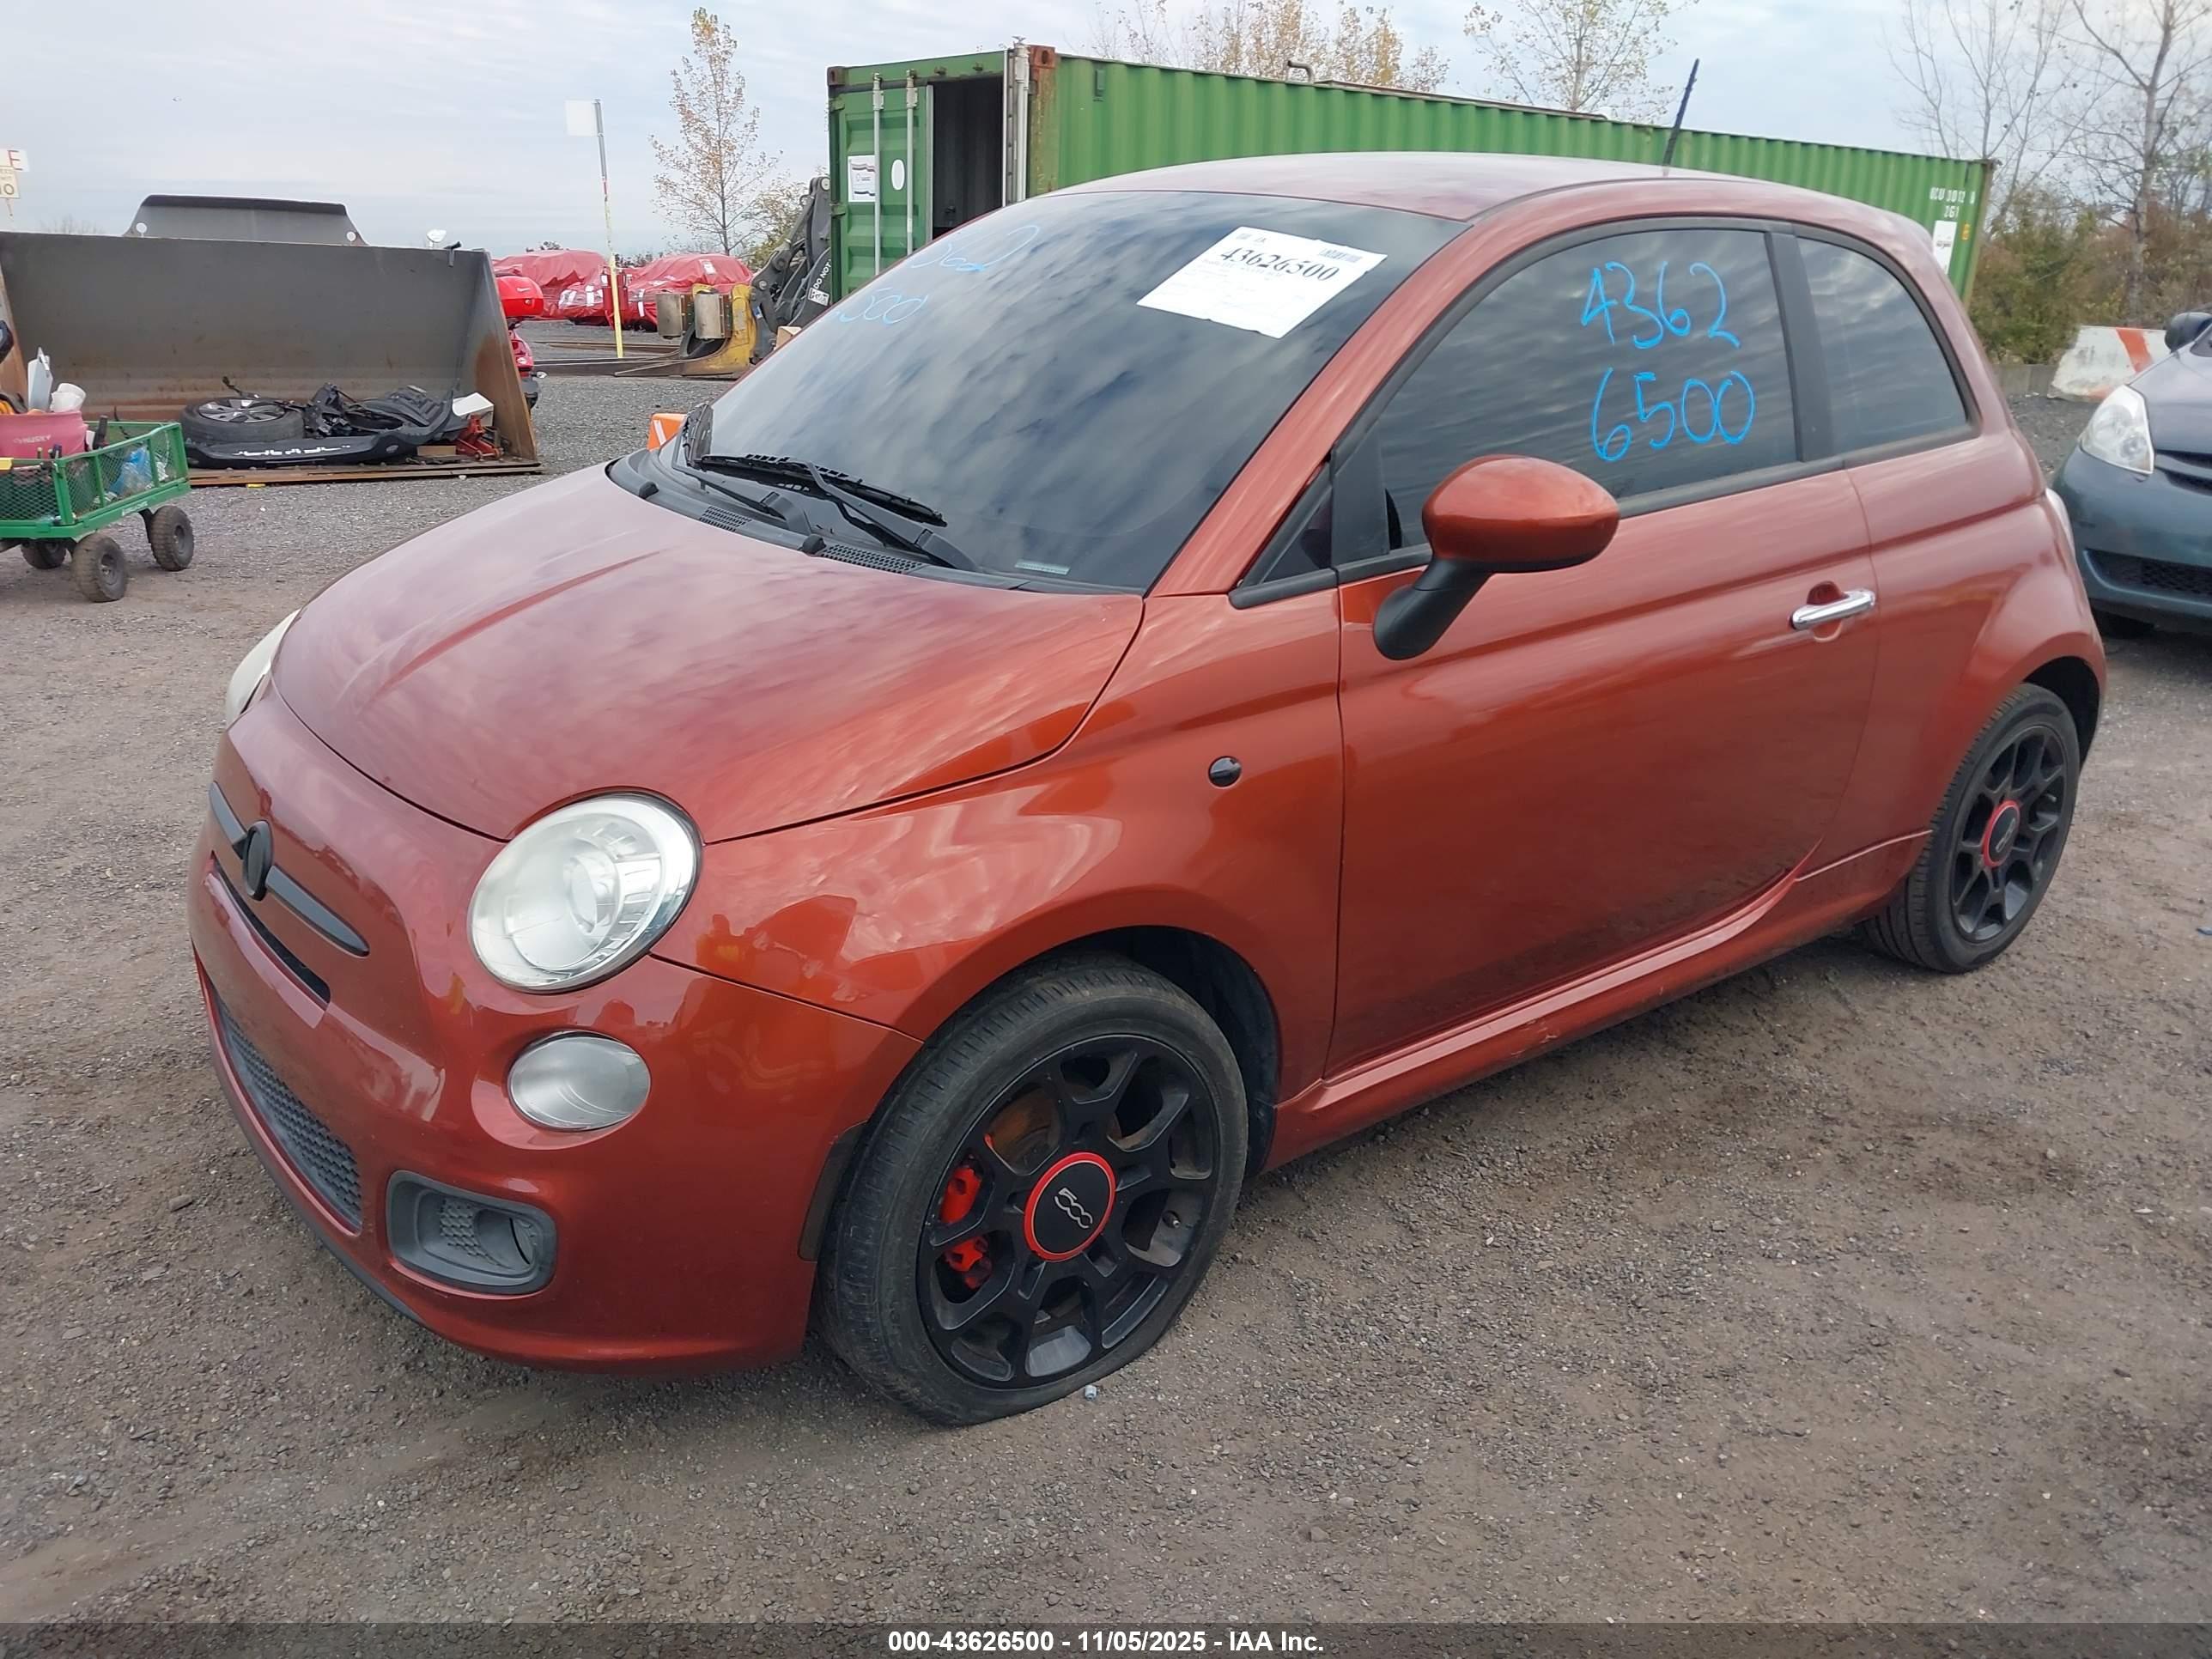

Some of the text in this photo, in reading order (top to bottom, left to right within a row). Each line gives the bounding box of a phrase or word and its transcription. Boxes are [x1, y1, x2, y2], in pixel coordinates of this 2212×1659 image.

[0, 183, 15, 195] 0
[1219, 246, 1340, 282] 43626500
[1581, 260, 1741, 349] 4362
[1591, 367, 1756, 462] 6500
[1054, 1187, 1094, 1230] 500
